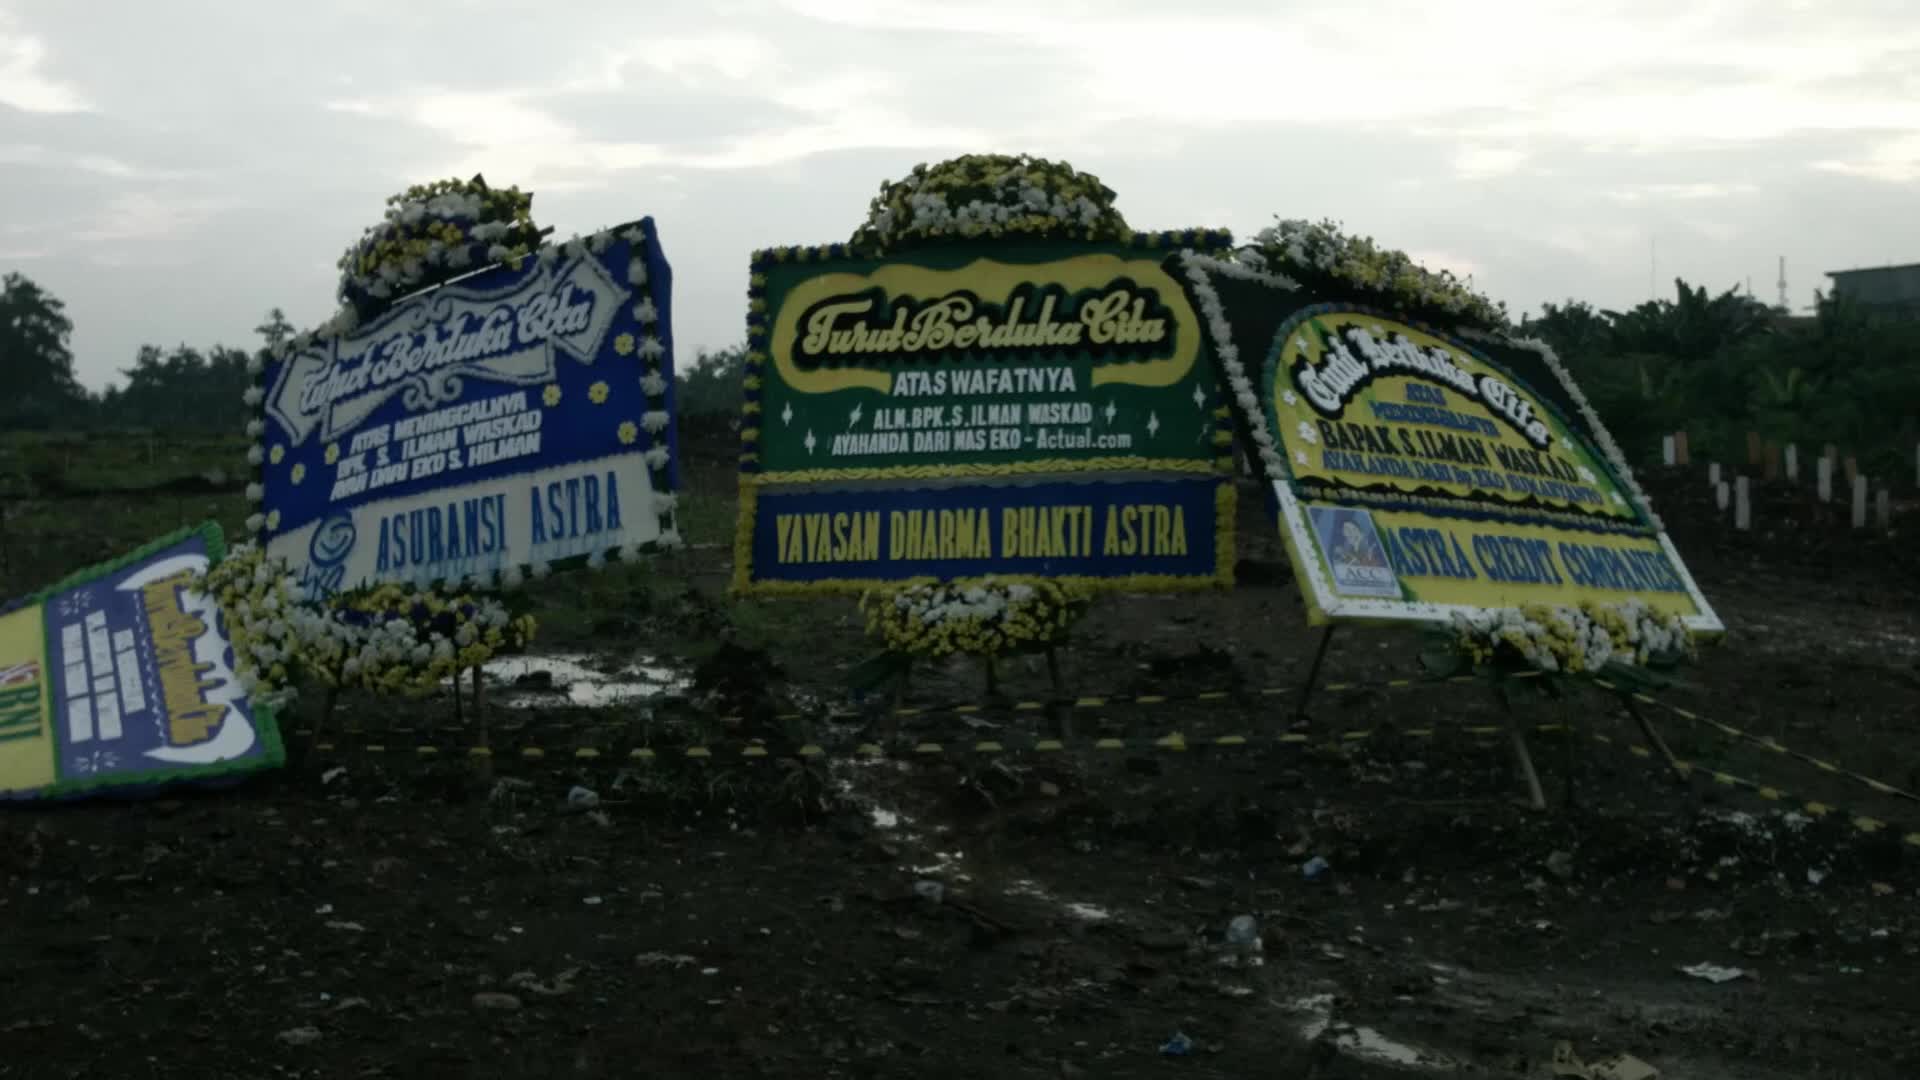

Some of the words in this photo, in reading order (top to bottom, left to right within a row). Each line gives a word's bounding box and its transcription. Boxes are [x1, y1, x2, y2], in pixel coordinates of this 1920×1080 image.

[373, 310, 513, 383] Berduka
[517, 285, 591, 343] Cita
[801, 299, 906, 356] Turut
[903, 295, 1082, 353] Berduka
[1080, 289, 1167, 345] Cita
[893, 370, 947, 397] ATAS
[951, 367, 1076, 394] WAFATNYA
[463, 409, 543, 445] WASKAD
[832, 432, 909, 456] AYAHANDA
[913, 431, 950, 453] DARI
[954, 429, 986, 451] MAS
[990, 429, 1020, 449] EKO
[1037, 427, 1132, 450] Actual.com
[1028, 403, 1093, 425] WASKAD
[467, 431, 541, 467] HILMAN
[1317, 418, 1401, 455] BAPAK
[1490, 442, 1579, 482] WASKAD
[376, 494, 506, 572] ASURANSI
[530, 471, 622, 544] ASTRA
[776, 511, 880, 564] YAYASAN
[889, 507, 991, 561] DHARMA
[1001, 505, 1093, 558] BHAKTI
[1102, 504, 1188, 557] ASTRA
[1387, 528, 1477, 578] ASTRA
[1472, 533, 1563, 585] CREDIT
[1558, 541, 1690, 593] COMPANIES
